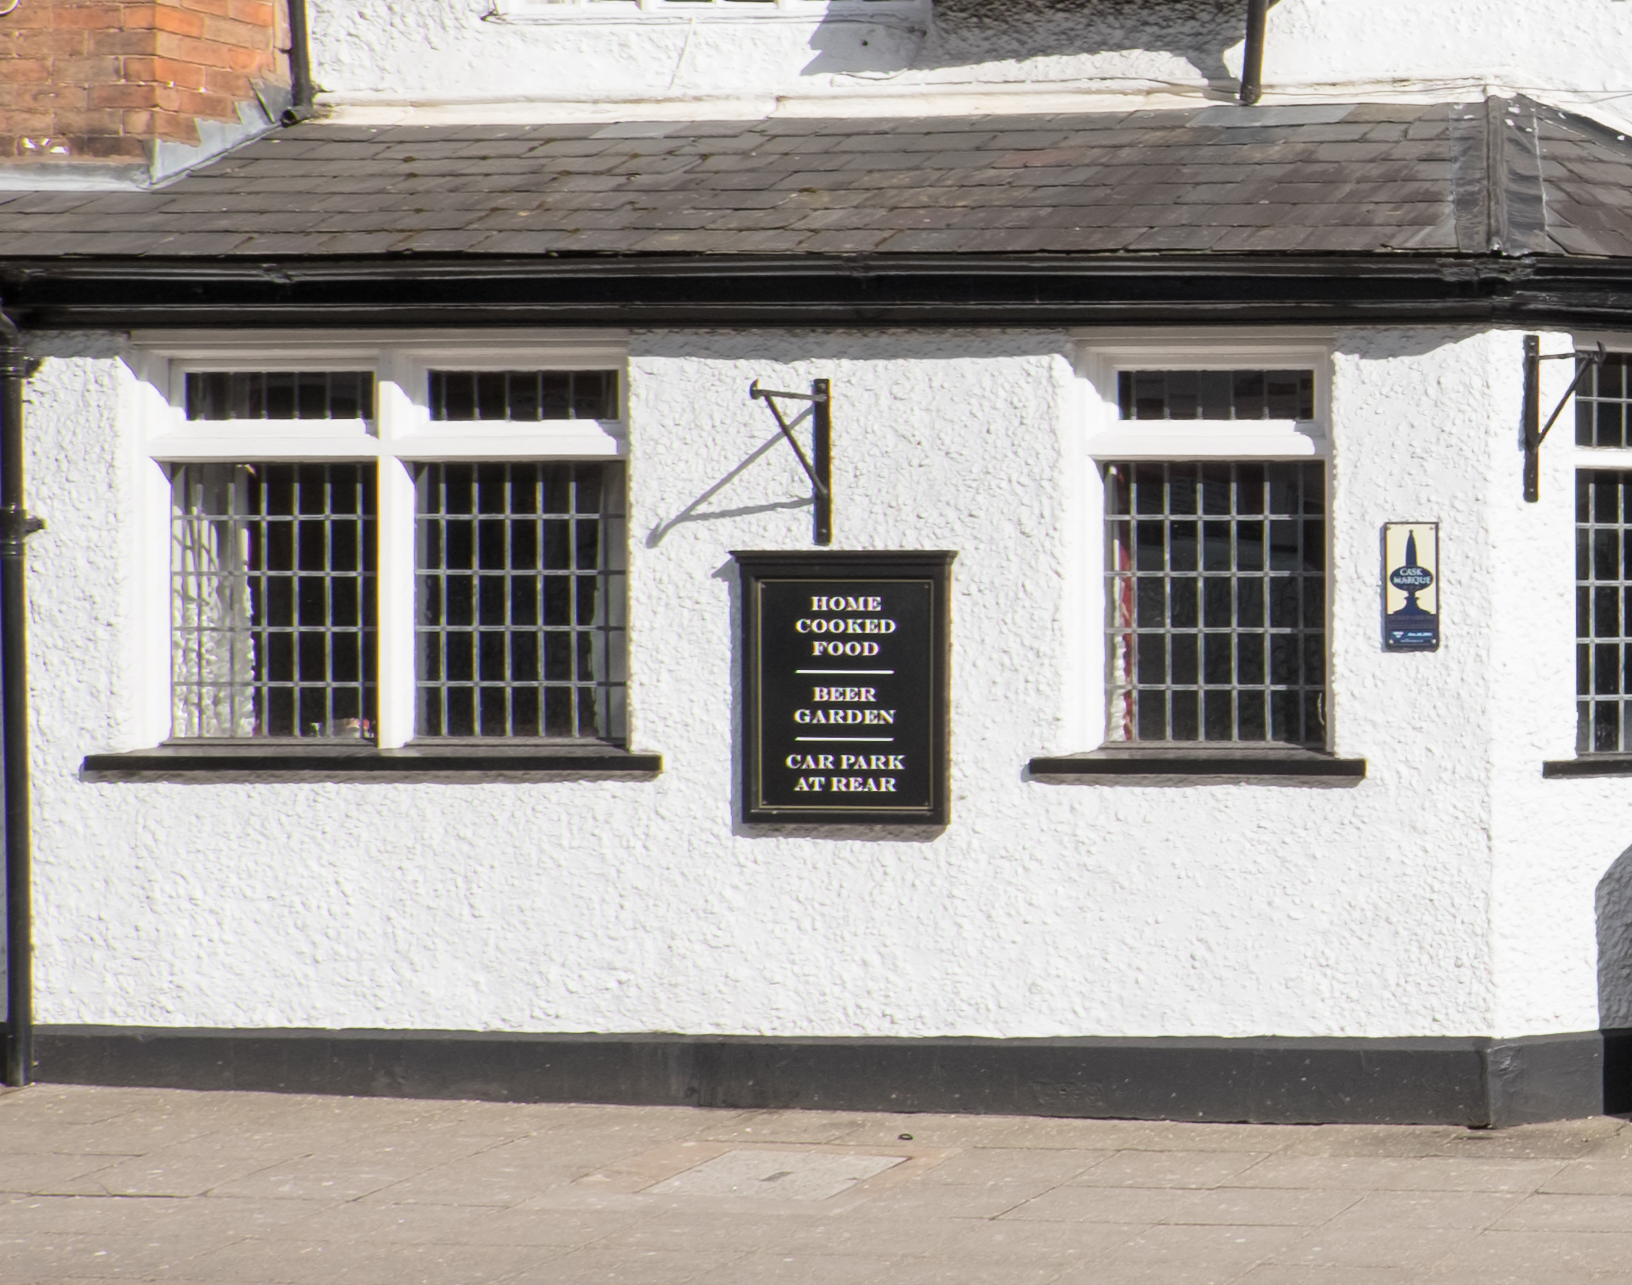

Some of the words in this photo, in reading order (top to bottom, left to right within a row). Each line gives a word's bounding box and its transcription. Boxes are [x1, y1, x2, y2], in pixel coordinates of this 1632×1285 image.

[1400, 568, 1423, 576] CASK
[1393, 576, 1431, 585] MARQUE
[811, 596, 882, 611] HOME
[795, 619, 897, 634] COOKED
[812, 641, 880, 656] FOOD
[813, 687, 876, 702] BEER
[794, 709, 897, 724] GARDEN
[786, 754, 835, 770] CAR
[840, 754, 906, 770] PARK
[793, 777, 825, 792] AT
[830, 777, 897, 792] REAR
